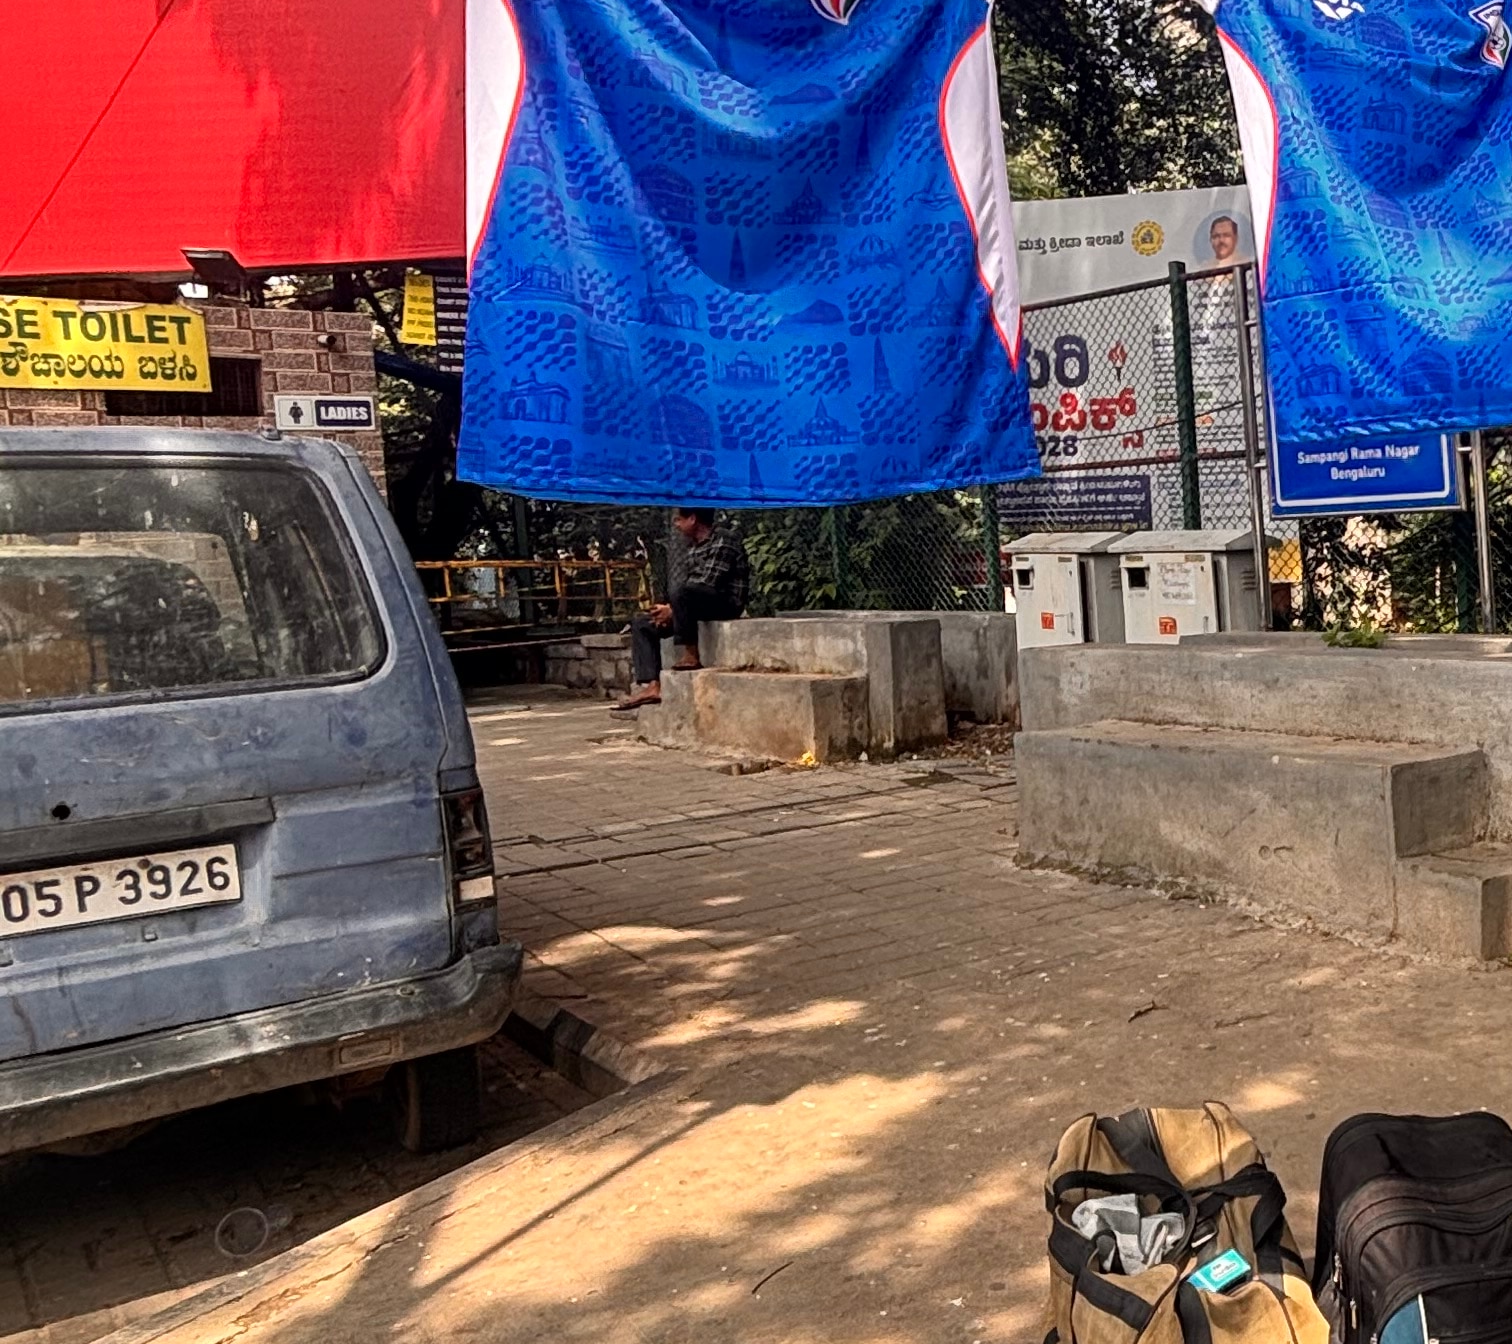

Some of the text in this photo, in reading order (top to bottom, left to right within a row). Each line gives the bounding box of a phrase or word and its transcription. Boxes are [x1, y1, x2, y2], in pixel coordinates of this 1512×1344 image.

[52, 309, 191, 346] TOILET
[320, 406, 369, 421] LADIES
[1297, 448, 1349, 465] Sampangi
[1384, 444, 1420, 460] Nagar
[1330, 465, 1386, 482] Bengaluru
[1, 856, 231, 923] 05 P 3926
